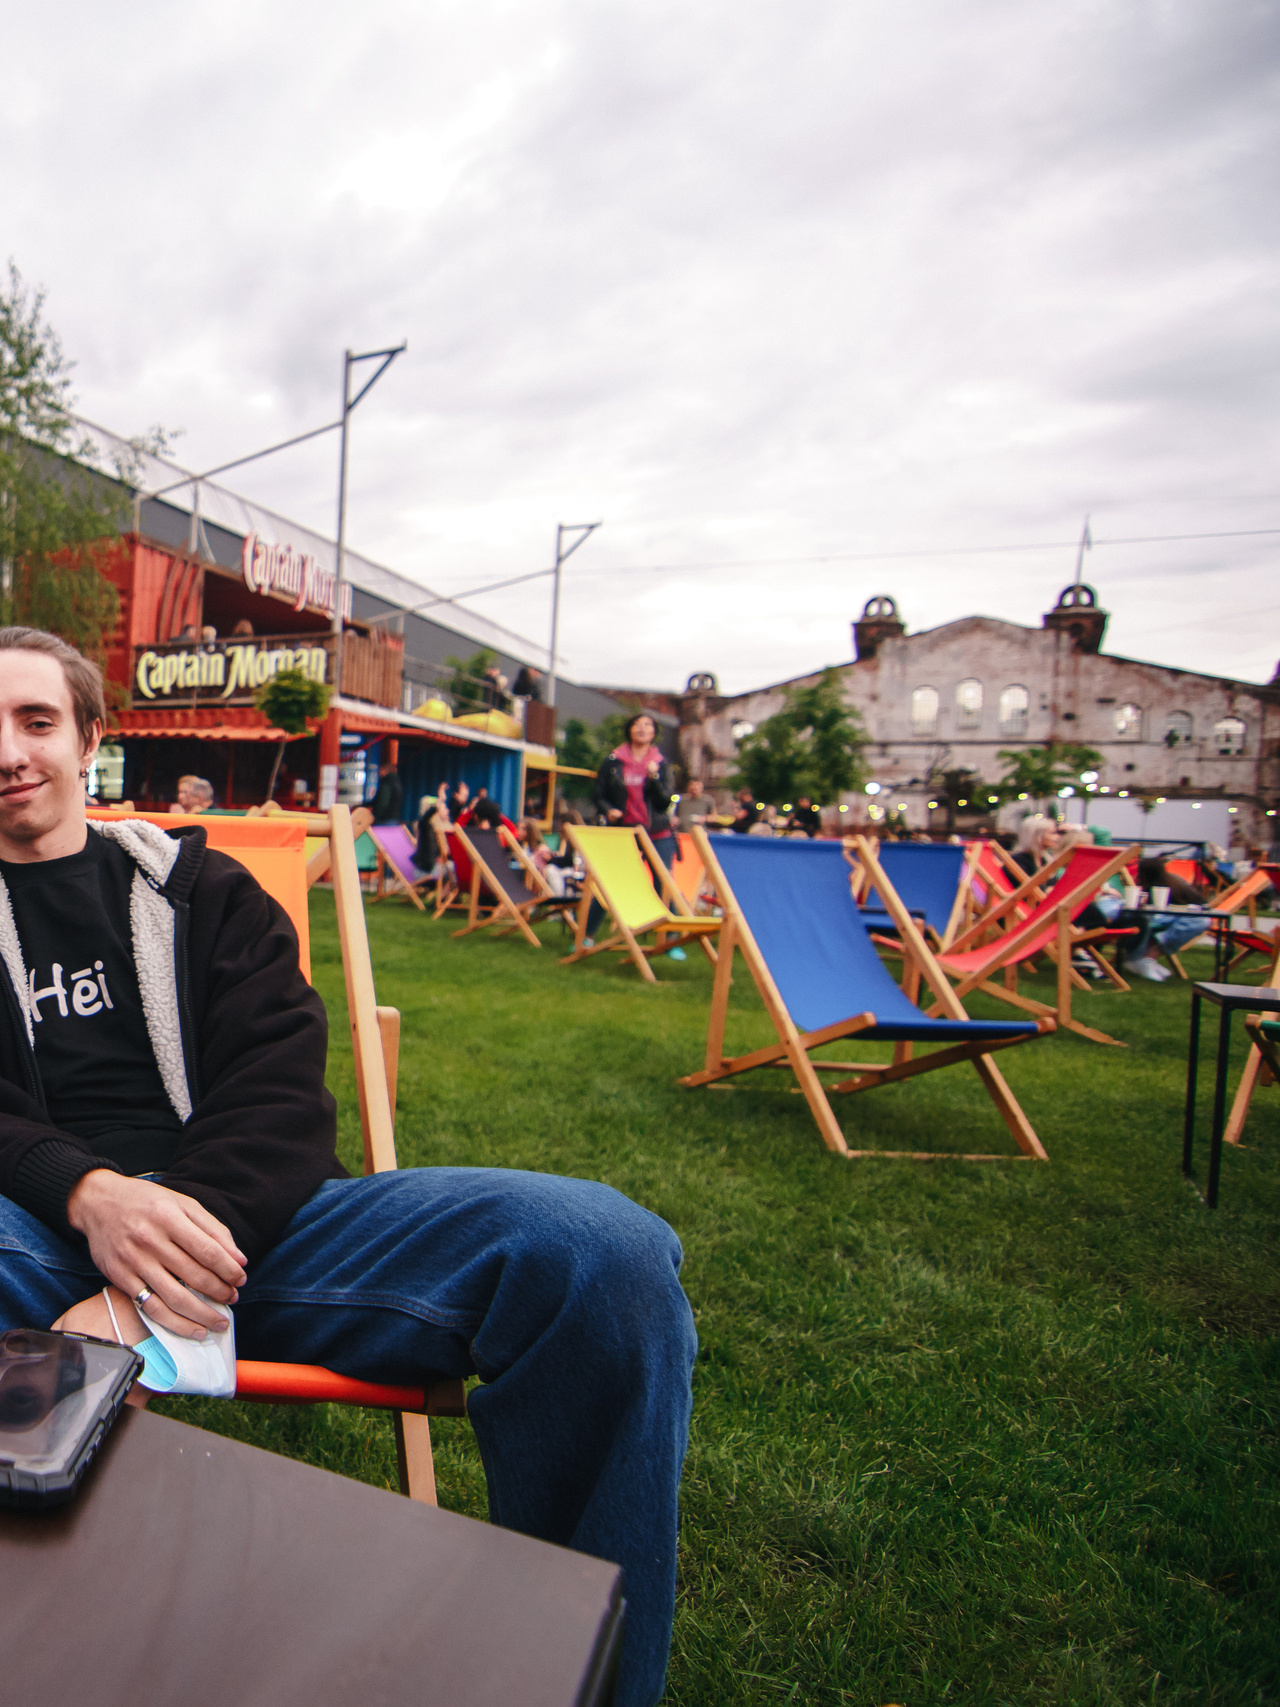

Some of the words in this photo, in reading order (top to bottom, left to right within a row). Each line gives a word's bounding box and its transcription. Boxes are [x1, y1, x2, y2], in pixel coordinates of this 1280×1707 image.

[242, 531, 302, 597] Captain
[293, 553, 353, 625] Morgn
[136, 650, 226, 699] Captain
[28, 960, 114, 1023] Hēi
